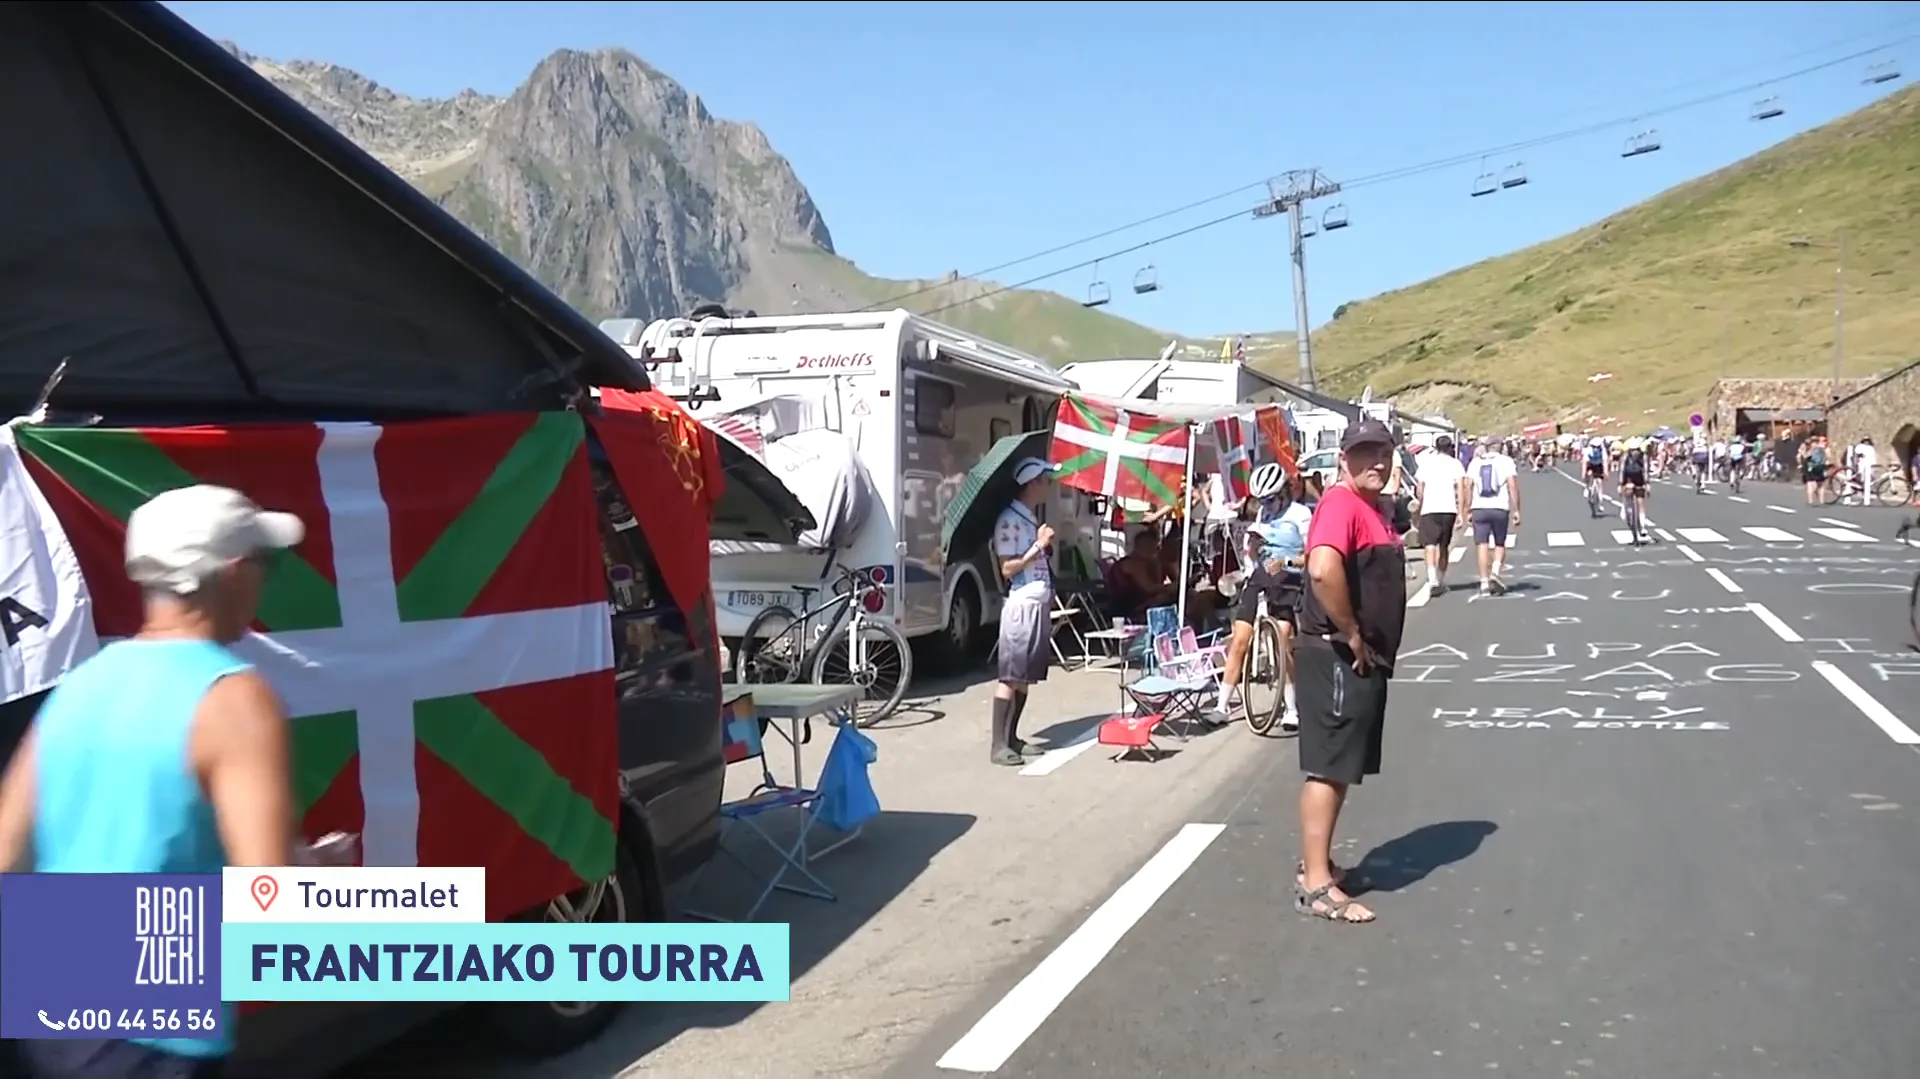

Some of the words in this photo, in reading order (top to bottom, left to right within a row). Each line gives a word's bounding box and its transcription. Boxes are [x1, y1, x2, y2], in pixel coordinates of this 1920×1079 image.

[795, 352, 874, 369] Dethleffs
[736, 593, 765, 606] 1089
[1396, 641, 1720, 660] AUPA
[1432, 706, 1705, 719] HEALY
[1444, 720, 1551, 729] YOUR
[1573, 720, 1730, 731] BOTTLE
